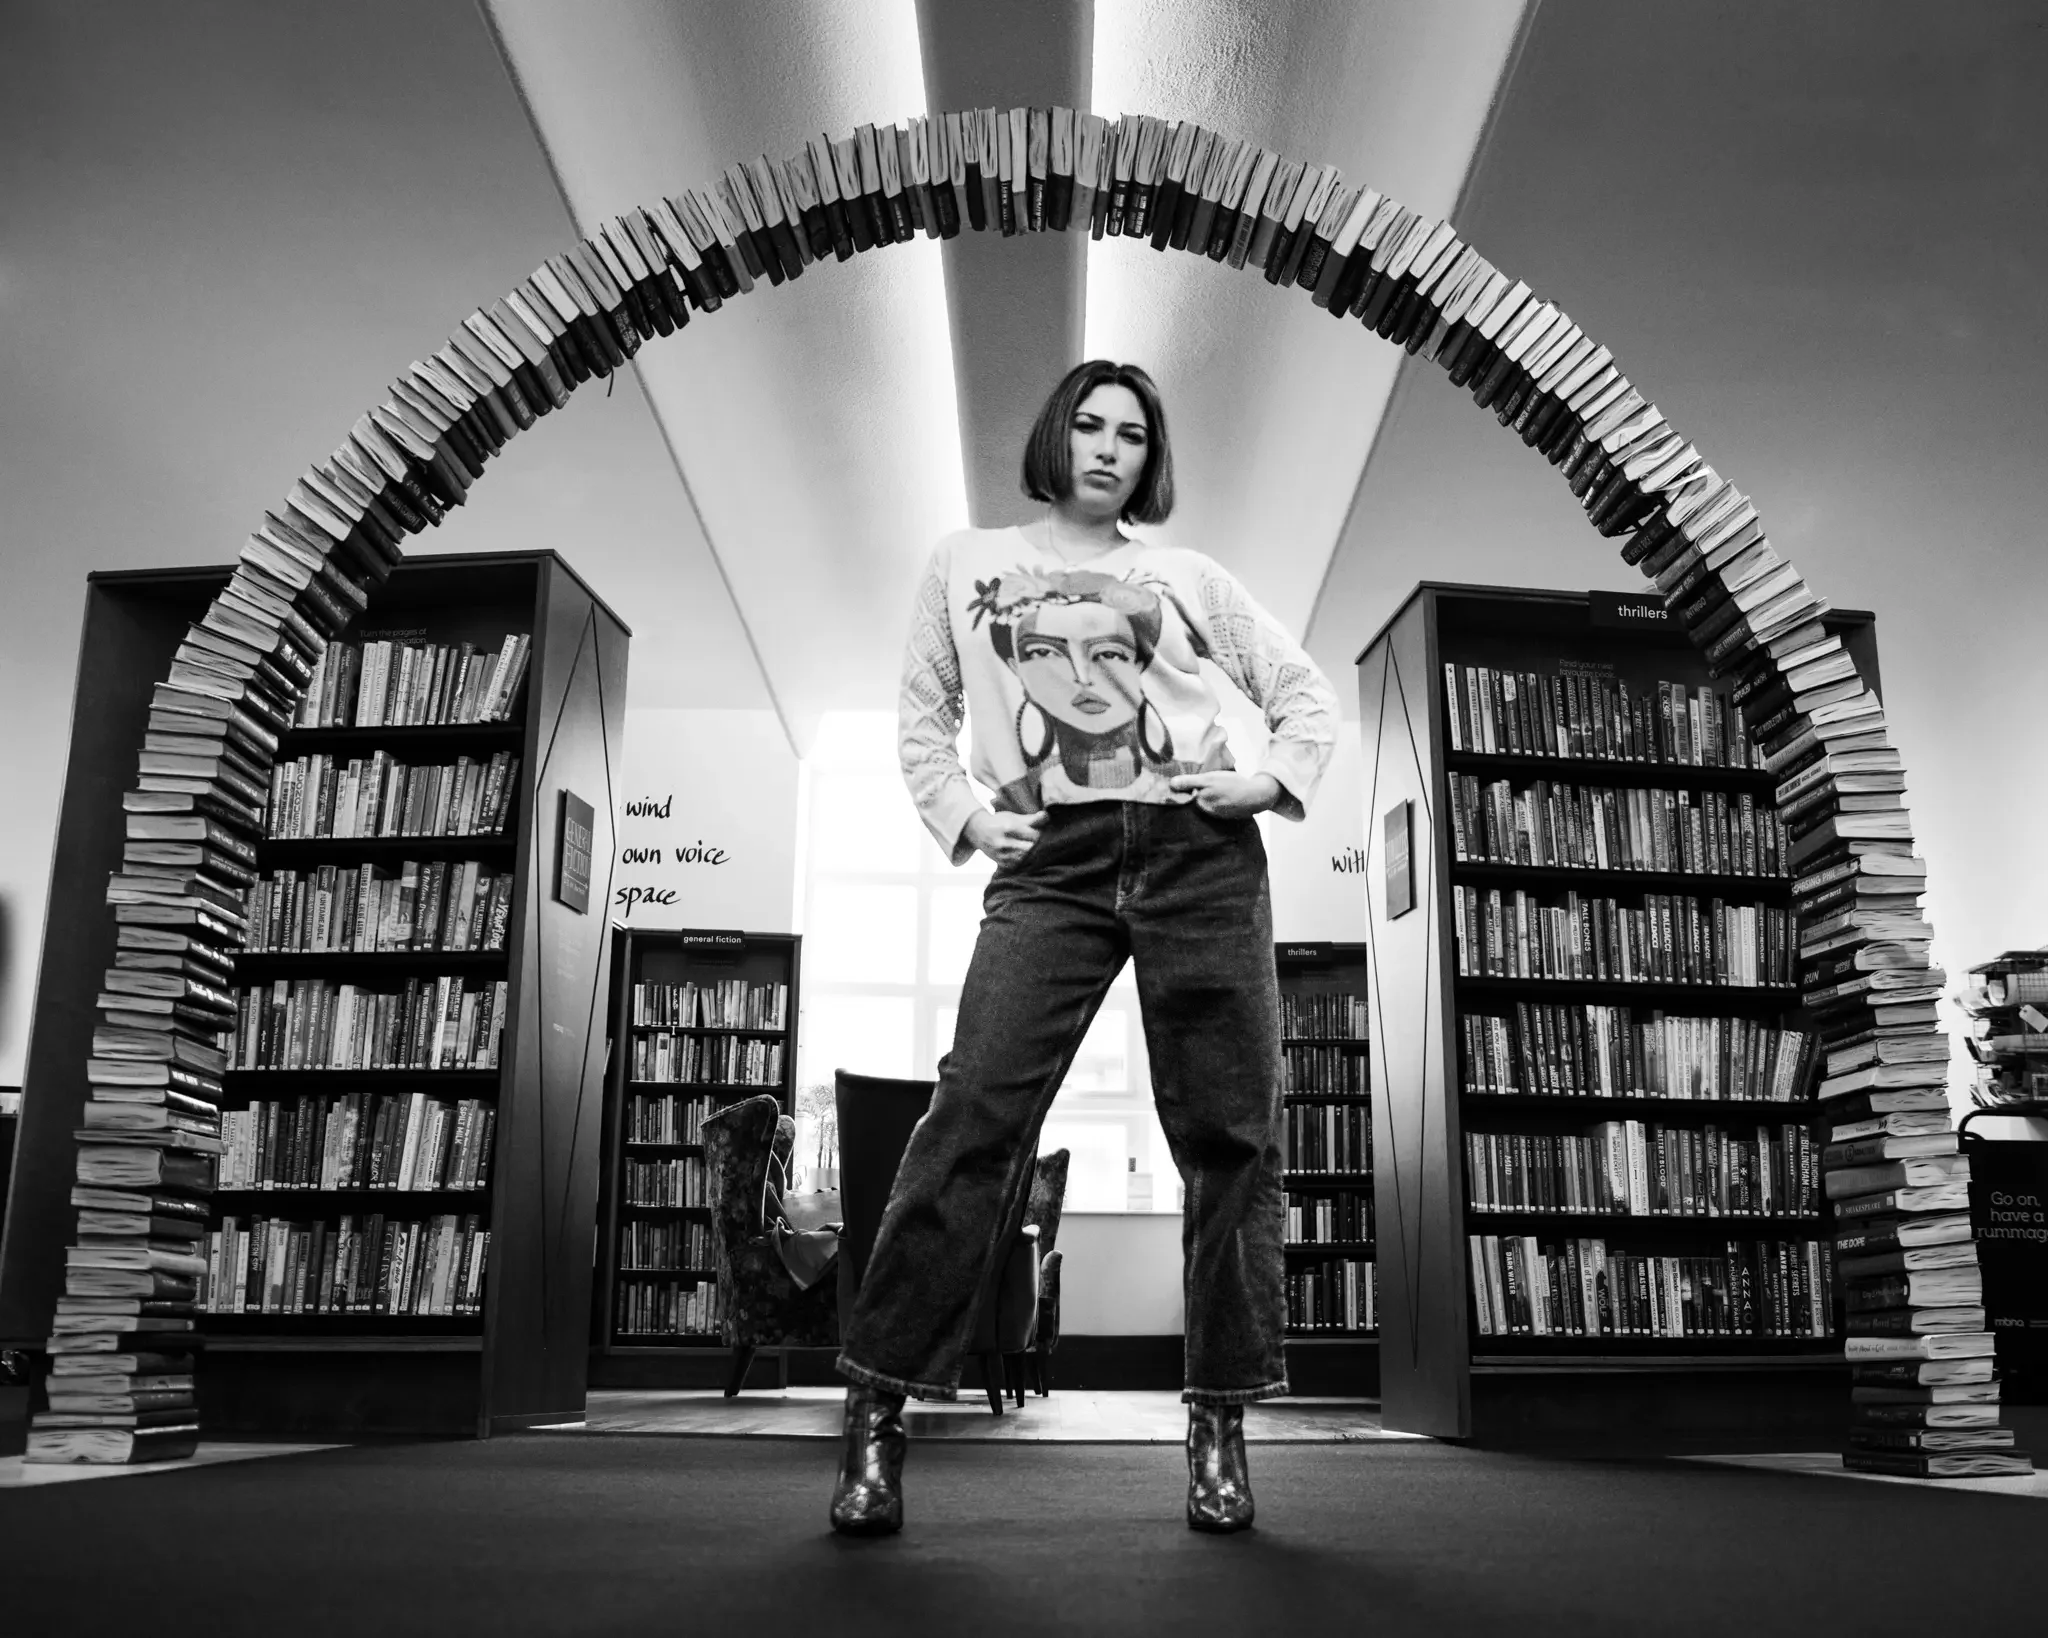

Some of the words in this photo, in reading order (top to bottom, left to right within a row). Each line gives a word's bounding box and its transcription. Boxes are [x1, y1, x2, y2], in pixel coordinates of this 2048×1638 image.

[1617, 605, 1668, 620] thrillers
[1685, 595, 1707, 620] INTRIGO
[392, 629, 417, 638] pages
[292, 774, 304, 837] CONQUEST
[626, 794, 673, 819] wind
[564, 842, 591, 879] FICTION
[622, 847, 661, 864] own
[675, 839, 732, 866] voice
[420, 875, 429, 901] Million
[614, 885, 681, 918] space
[272, 909, 280, 920] TEAM
[317, 897, 326, 942] UNTAMEABLE
[416, 903, 426, 930] Dreams
[475, 914, 484, 939] ATKINSON
[492, 904, 509, 926] YEAR
[305, 915, 313, 941] HERON
[683, 935, 714, 944] general
[715, 935, 742, 944] fiction
[1650, 912, 1658, 948] BALDACCI
[1662, 912, 1671, 952] BALDACCI
[1692, 913, 1700, 953] BALDACCI
[1287, 948, 1317, 956] thrillers
[1803, 968, 1820, 984] RUN
[296, 987, 304, 1006] Honey
[454, 979, 462, 1004] MICHAEL
[418, 1019, 426, 1047] DAUGHTERS
[298, 1098, 306, 1127] Sebastian
[457, 1106, 468, 1126] SPILT
[295, 1127, 303, 1142] Barry
[455, 1127, 463, 1144] MILK
[1801, 1140, 1810, 1185] BILLINGHAM
[1845, 1201, 1881, 1214] SHAKESPEARE
[1990, 1191, 2014, 1206] Go
[1989, 1207, 2030, 1223] have
[2032, 1211, 2045, 1223] a
[251, 1223, 261, 1256] NORTHERN
[1836, 1238, 1849, 1251] THE
[1849, 1236, 1866, 1248] DOPE
[1977, 1226, 2048, 1243] rummag
[1506, 1251, 1514, 1270] DARK
[1567, 1245, 1576, 1268] SWEET
[1581, 1246, 1590, 1268] Ritual
[1789, 1246, 1797, 1269] DEADLY
[1479, 1282, 1487, 1301] Wrong
[1508, 1271, 1516, 1295] WATER
[1741, 1267, 1752, 1310] ANNA
[1792, 1270, 1800, 1296] SECRETS
[1598, 1289, 1607, 1317] WOLF
[1993, 1317, 2025, 1328] mbna
